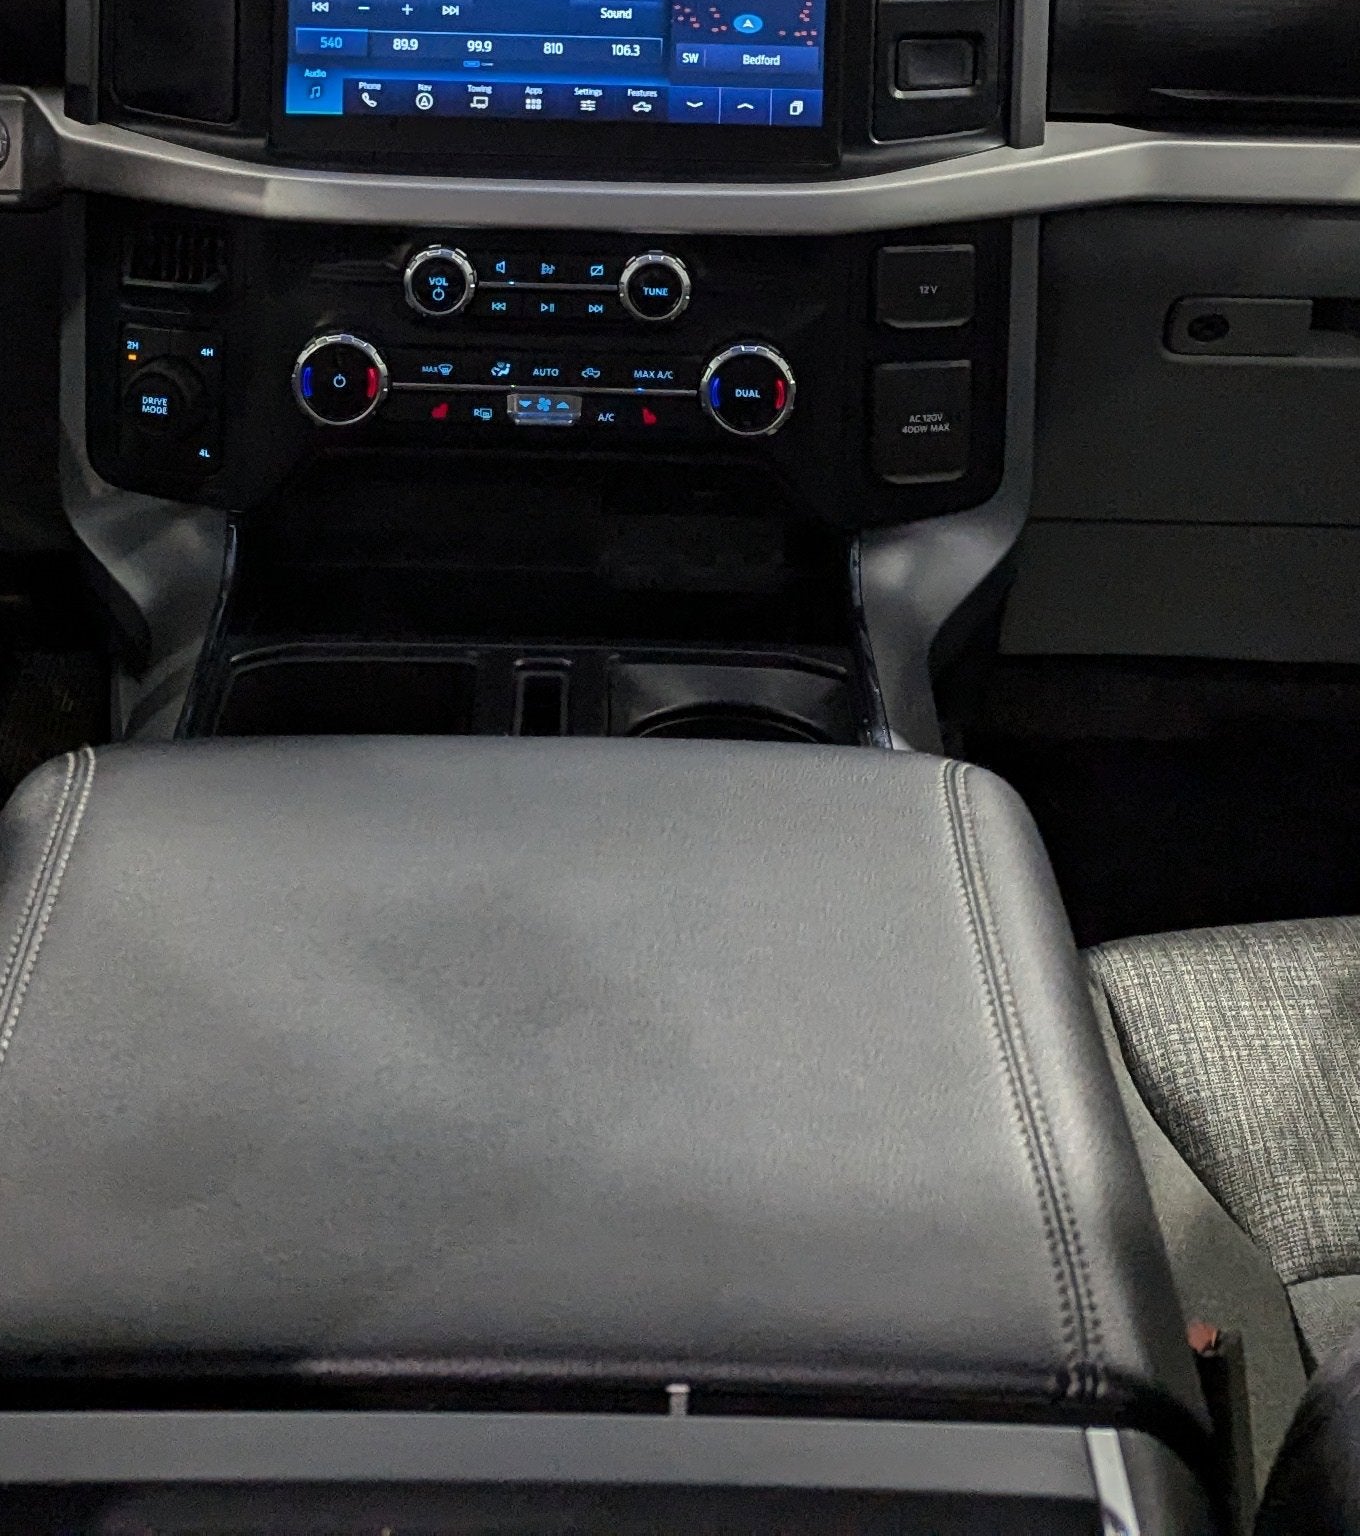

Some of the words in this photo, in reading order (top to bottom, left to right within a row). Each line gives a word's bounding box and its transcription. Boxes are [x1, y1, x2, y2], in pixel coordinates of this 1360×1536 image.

[600, 8, 632, 19] Sound
[320, 37, 343, 49] 540
[392, 39, 419, 51] 89.9
[467, 40, 493, 52] 99.9
[543, 42, 563, 55] 810
[612, 44, 640, 56] 106.3
[682, 53, 699, 64] SW
[742, 54, 781, 66] Bedford
[304, 69, 327, 78] Audio
[358, 82, 381, 91] Phone
[418, 83, 432, 92] Nav
[467, 84, 493, 94] Towing
[525, 86, 543, 96] Apps
[574, 87, 603, 97] Settings
[627, 89, 658, 98] Features
[429, 277, 448, 287] VOL
[643, 287, 668, 297] TUNE
[126, 340, 139, 350] 2H
[201, 348, 214, 356] 4H
[532, 368, 559, 377] AUTO
[634, 370, 655, 379] MAX
[657, 370, 674, 380] A/C
[735, 389, 760, 398] DUAL
[142, 396, 168, 406] DRIVE
[142, 405, 168, 415] MODE
[598, 413, 615, 423] A/C
[909, 415, 921, 423] AC
[923, 414, 944, 422] 120V
[902, 425, 928, 433] 400W
[930, 423, 950, 432] MAX
[199, 449, 210, 458] 4L
